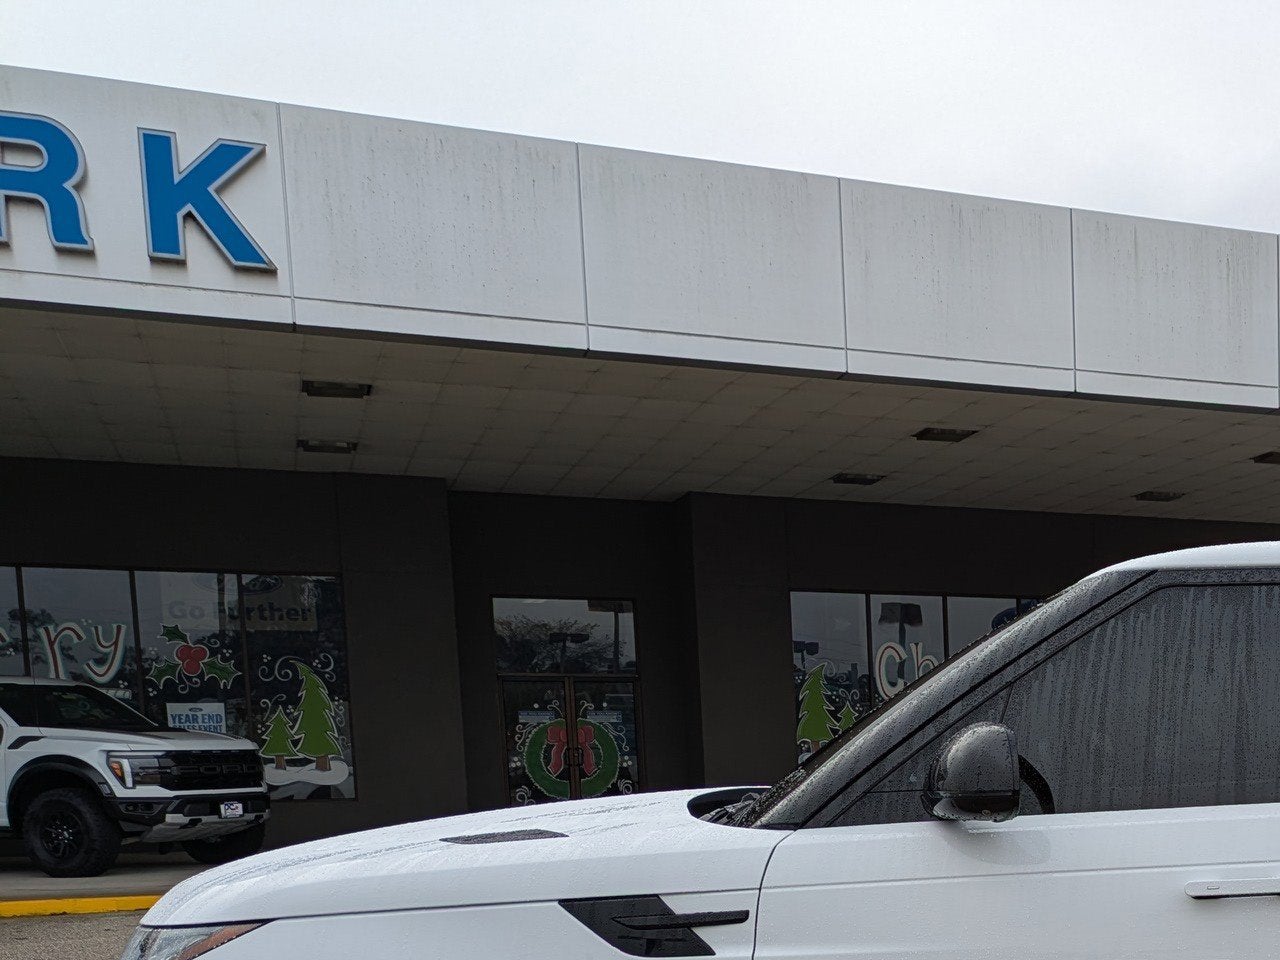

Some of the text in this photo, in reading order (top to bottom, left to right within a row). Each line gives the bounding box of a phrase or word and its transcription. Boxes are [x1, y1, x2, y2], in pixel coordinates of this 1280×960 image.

[168, 600, 206, 620] Go
[0, 622, 127, 684] ry
[170, 713, 223, 724] YEAR END
